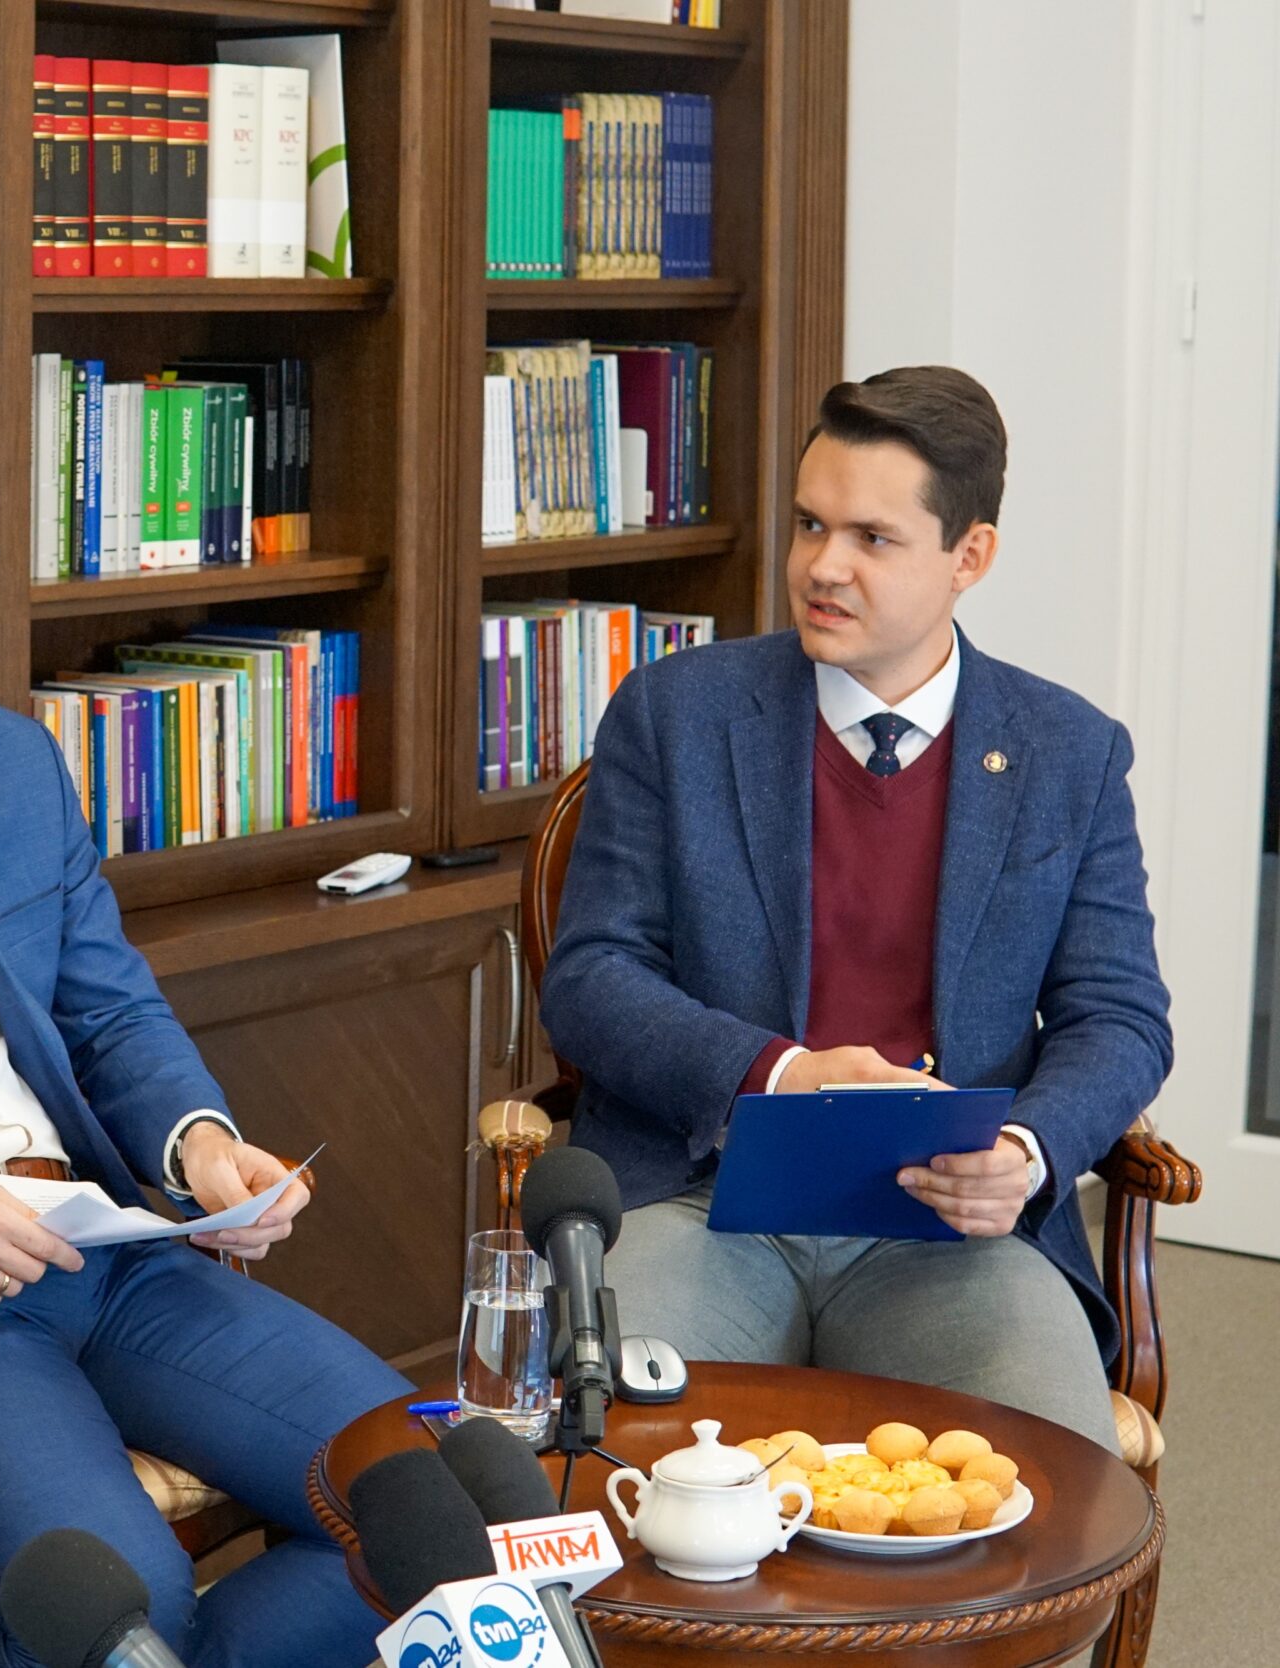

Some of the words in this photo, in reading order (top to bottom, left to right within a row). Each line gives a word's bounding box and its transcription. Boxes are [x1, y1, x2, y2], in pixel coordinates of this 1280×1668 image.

[233, 128, 253, 142] KPC
[279, 129, 300, 144] KPC
[74, 393, 85, 460] POSTĘPOWANIE
[149, 408, 159, 442] Zbiór
[182, 407, 193, 441] Zbiór
[75, 462, 84, 501] CYWILNE
[147, 444, 158, 493] cywilny
[180, 443, 192, 491] cywilny
[492, 1524, 600, 1572] TRWAM
